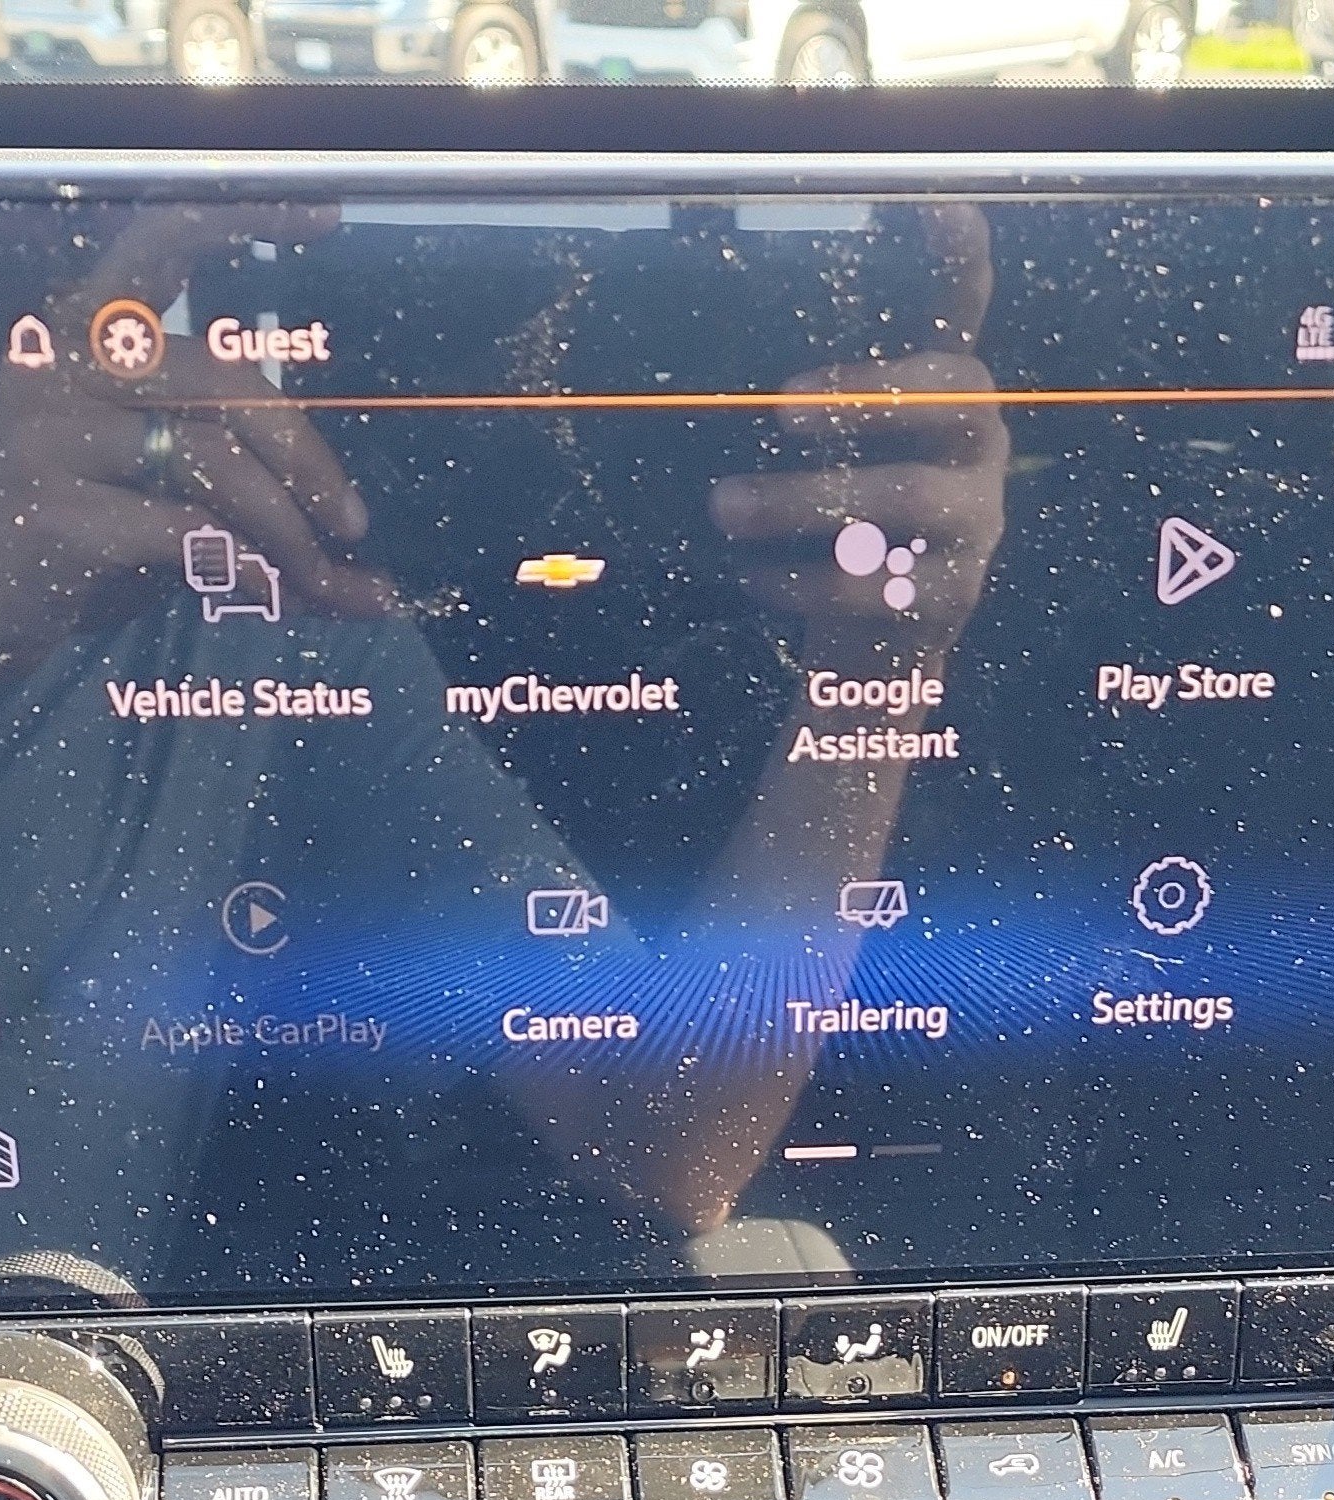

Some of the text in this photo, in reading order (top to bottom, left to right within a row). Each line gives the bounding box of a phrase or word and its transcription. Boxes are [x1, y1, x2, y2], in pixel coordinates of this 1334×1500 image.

[1299, 306, 1334, 327] 4G
[208, 317, 331, 363] Guest
[1297, 326, 1334, 347] LTE
[108, 677, 372, 719] Vehicle Status
[446, 674, 679, 724] myChevrolet
[809, 669, 943, 716] Google
[1097, 662, 1275, 709] Play Store
[788, 726, 960, 763] Assistant
[503, 1006, 640, 1042] Camera
[787, 1000, 949, 1039] Trailering
[1091, 990, 1234, 1029] Settings
[140, 1015, 387, 1055] Apple CarPlay
[970, 1324, 1050, 1350] ON/OFF
[1148, 1449, 1186, 1469] A/C
